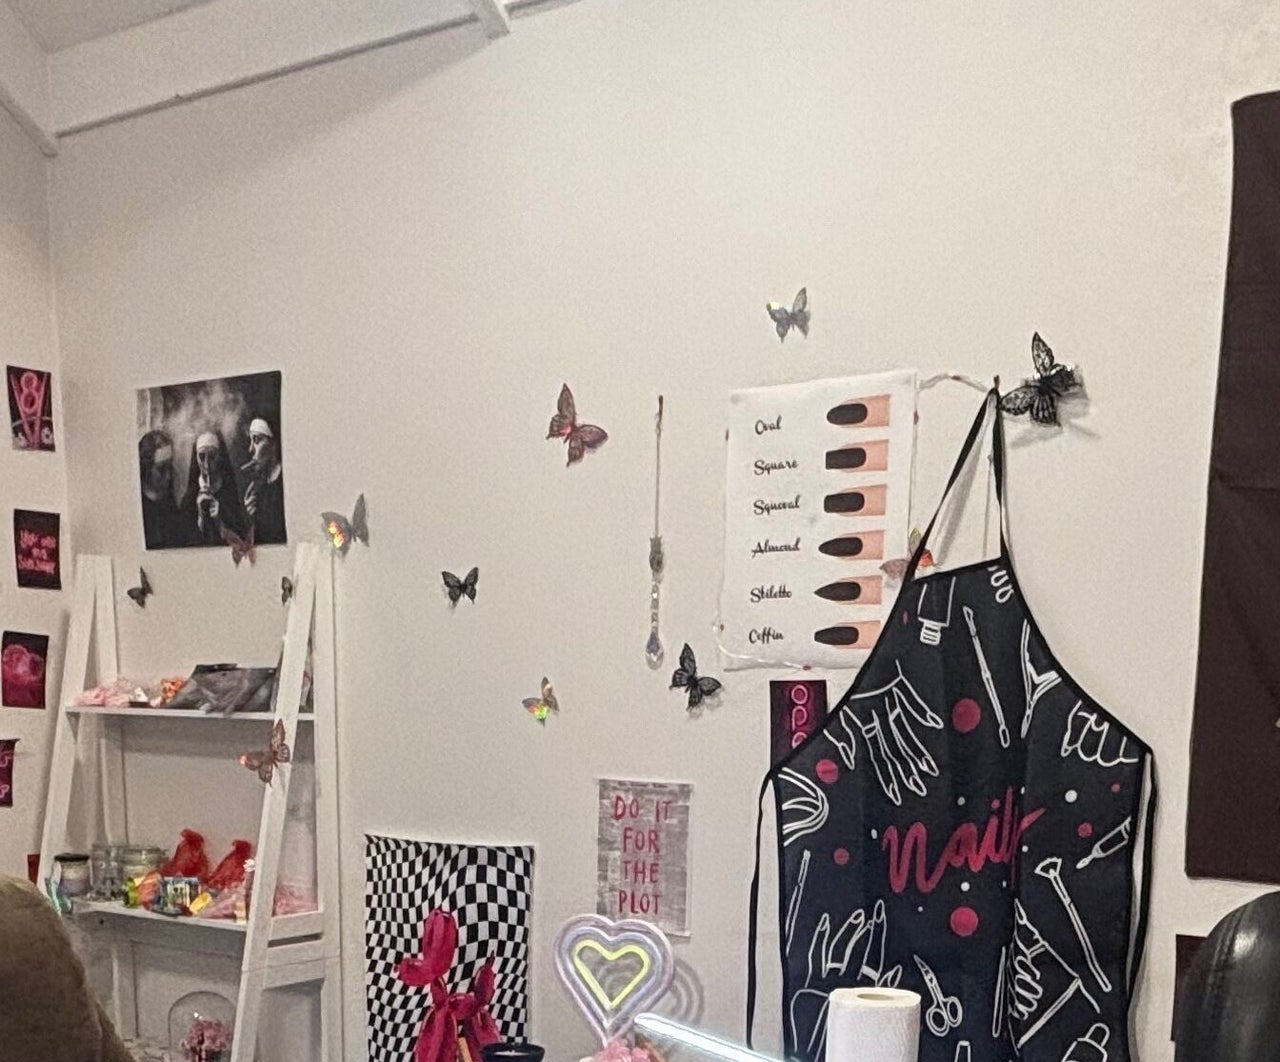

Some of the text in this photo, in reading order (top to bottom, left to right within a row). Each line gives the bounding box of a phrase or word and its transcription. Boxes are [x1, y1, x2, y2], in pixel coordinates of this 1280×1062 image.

[754, 414, 782, 435] Oval
[753, 459, 799, 476] Square
[751, 537, 801, 559] Almond
[749, 584, 793, 603] Stiletto
[748, 626, 784, 644] Coffin
[612, 795, 672, 822] DO IT
[623, 826, 660, 854] FOR
[623, 860, 660, 885] THE
[618, 889, 662, 915] PLOT
